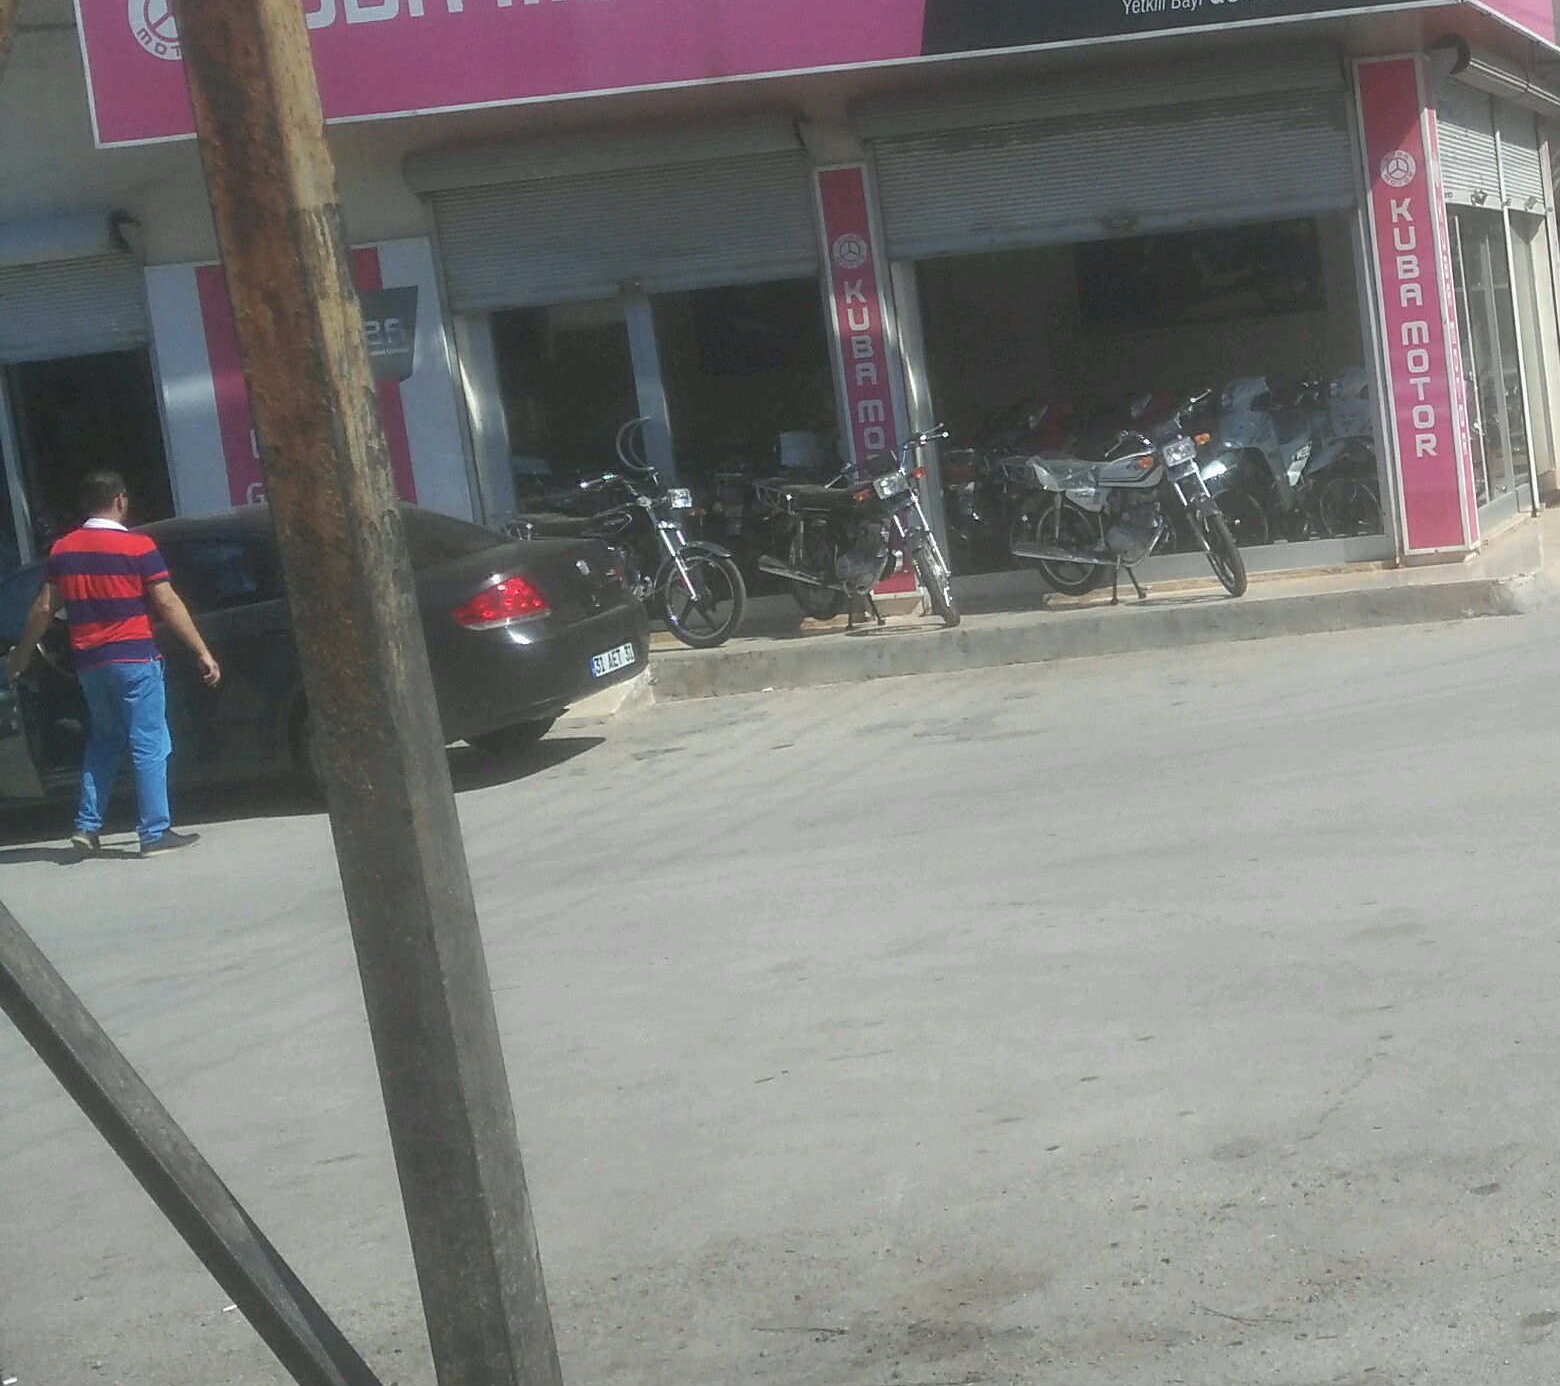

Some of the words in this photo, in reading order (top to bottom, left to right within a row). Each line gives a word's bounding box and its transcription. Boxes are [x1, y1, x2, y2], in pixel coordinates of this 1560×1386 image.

[136, 27, 181, 57] MOT
[1390, 197, 1423, 308] KUBA
[843, 279, 878, 386] KUBA
[1401, 320, 1438, 457] MOTOR
[594, 656, 606, 674] 31
